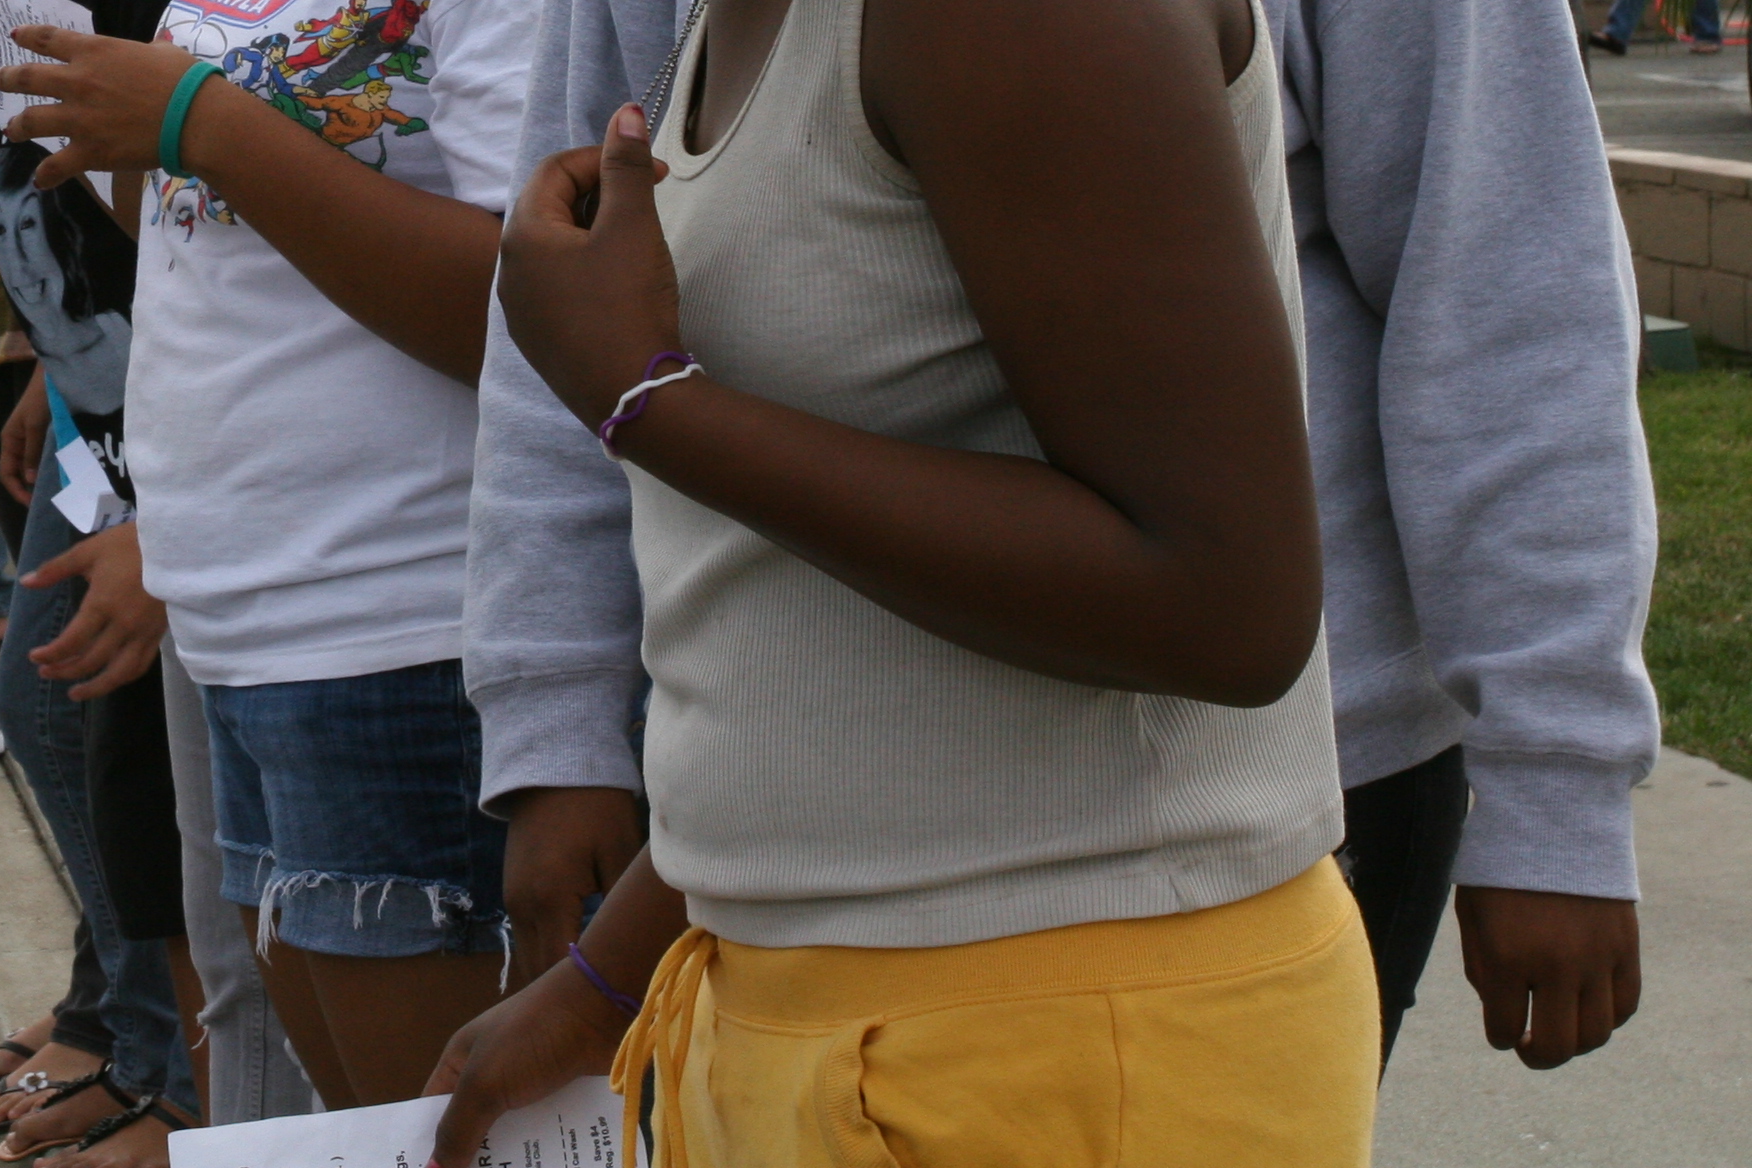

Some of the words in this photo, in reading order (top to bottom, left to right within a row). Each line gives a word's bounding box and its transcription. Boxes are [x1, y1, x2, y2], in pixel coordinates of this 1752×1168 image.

[568, 1128, 578, 1151] Wash
[589, 1125, 599, 1138] $4
[598, 1116, 612, 1147] $10.99
[571, 1151, 580, 1167] Car
[592, 1137, 602, 1162] Save
